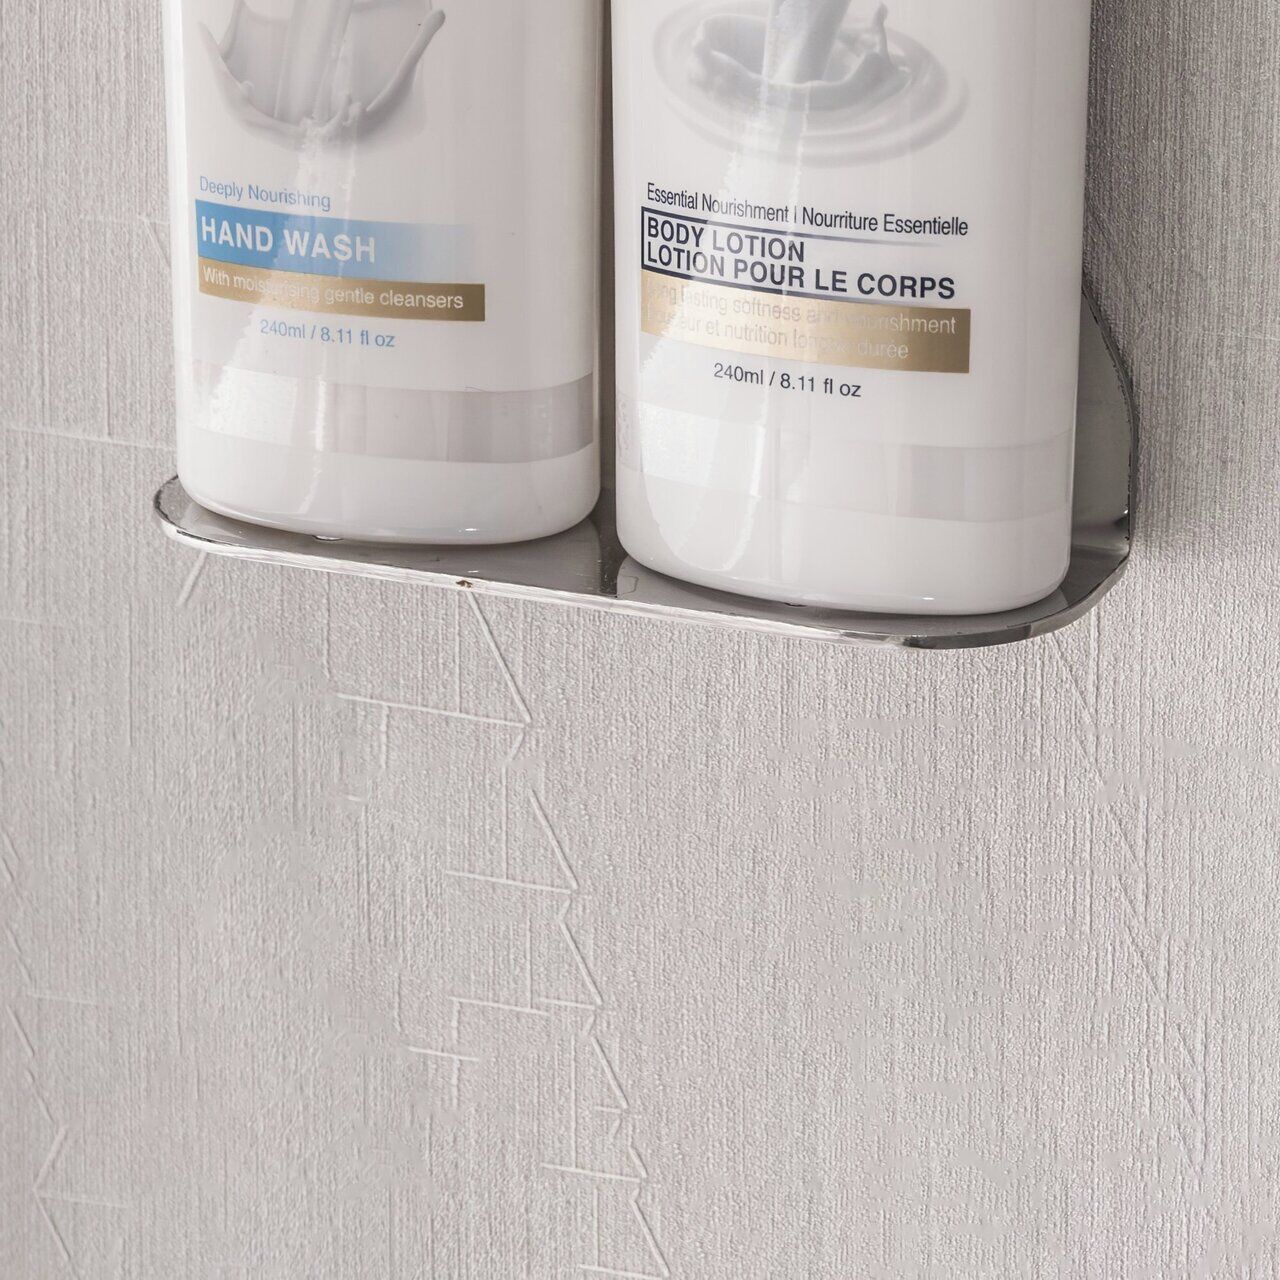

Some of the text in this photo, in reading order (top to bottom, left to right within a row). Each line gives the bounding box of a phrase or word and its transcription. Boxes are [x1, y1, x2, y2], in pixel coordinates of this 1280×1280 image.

[200, 176, 331, 212] Deeply Nourishing
[647, 182, 698, 211] Essential
[701, 193, 789, 223] Nourishment
[802, 206, 878, 232] Nourriture
[884, 213, 968, 236] Essentielle
[201, 216, 375, 264] HAND WASH
[647, 216, 805, 263] BODY LOTION
[202, 265, 230, 287] With
[325, 286, 375, 306] gentle
[380, 290, 464, 310] cleansers
[647, 241, 956, 300] LOTION POUR LE CORPS
[733, 296, 801, 322] softness
[260, 319, 306, 340] 240ml
[320, 326, 353, 345] 8.11
[360, 329, 371, 346] fl
[375, 333, 395, 348] oz
[724, 323, 788, 348] nutrition
[713, 362, 764, 385] 240ml
[780, 373, 816, 393] 8.11
[824, 377, 834, 395] fl
[840, 382, 862, 398] oz
